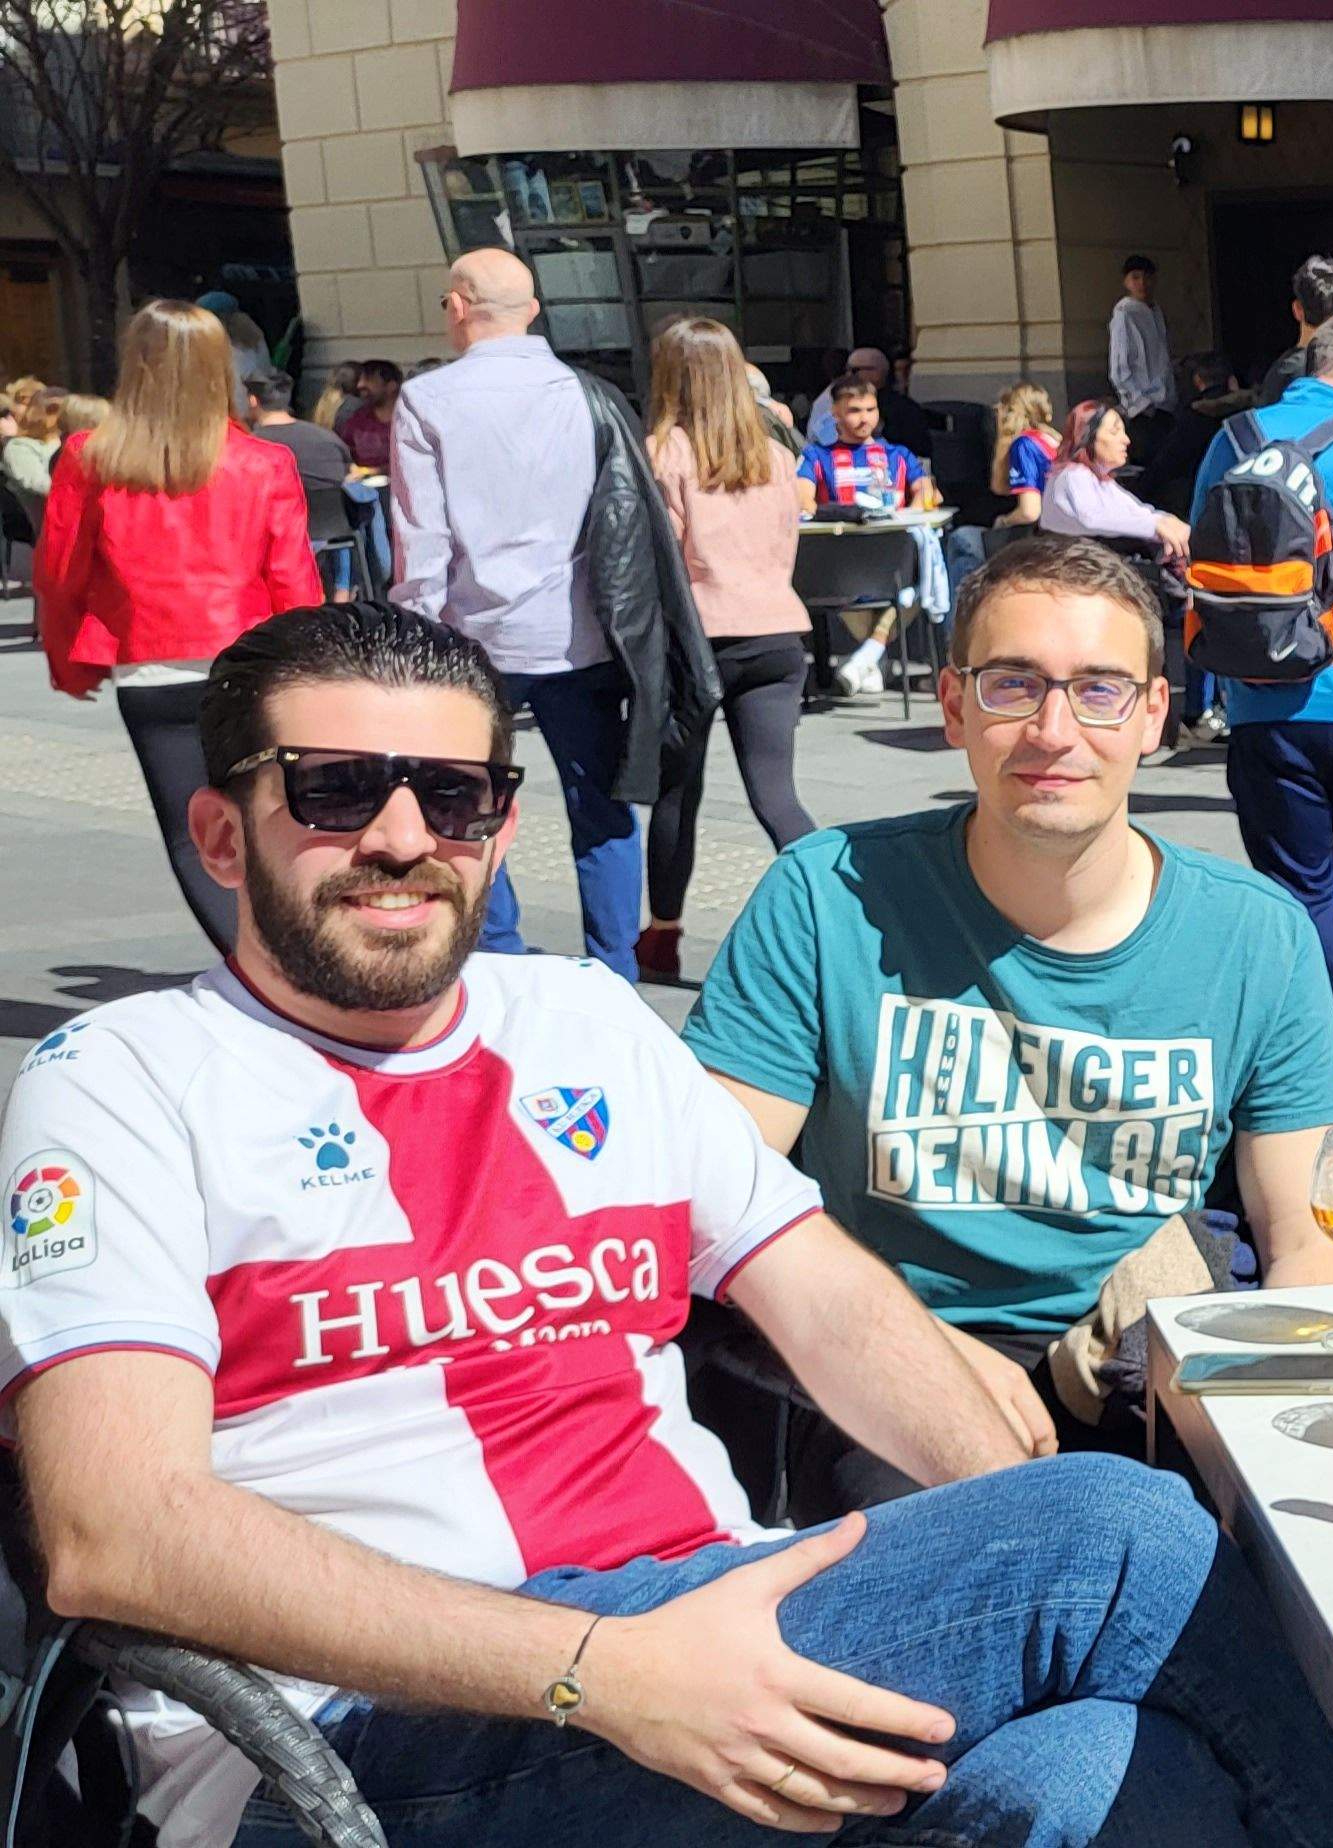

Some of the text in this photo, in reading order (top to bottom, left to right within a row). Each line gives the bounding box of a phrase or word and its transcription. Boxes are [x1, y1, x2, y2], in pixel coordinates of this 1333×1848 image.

[300, 1167, 376, 1191] KELME
[874, 1110, 1206, 1216] DENIM 85
[12, 1236, 85, 1273] LaLiga
[288, 1237, 661, 1369] Huesca
